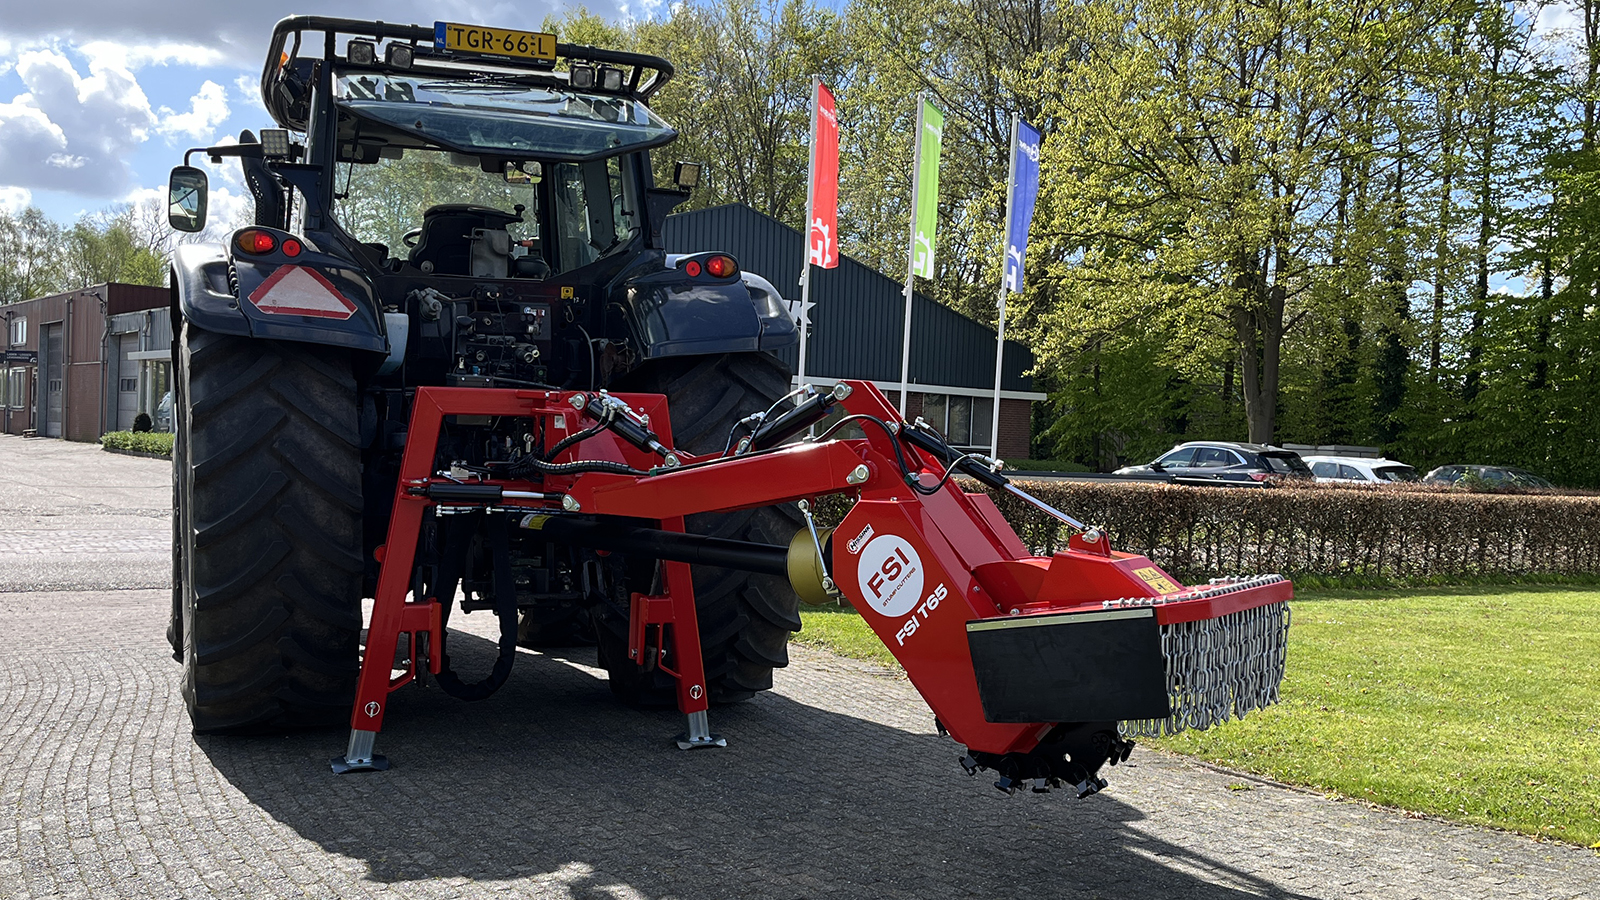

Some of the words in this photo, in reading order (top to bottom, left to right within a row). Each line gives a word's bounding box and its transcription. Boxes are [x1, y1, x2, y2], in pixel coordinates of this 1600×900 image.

[436, 37, 445, 45] NL
[453, 28, 548, 56] TGR-66-L
[866, 546, 910, 599] FSI
[882, 588, 897, 608] STUMP
[896, 566, 917, 591] CUTTERS
[895, 614, 921, 647] FSI
[917, 582, 949, 619] T65
